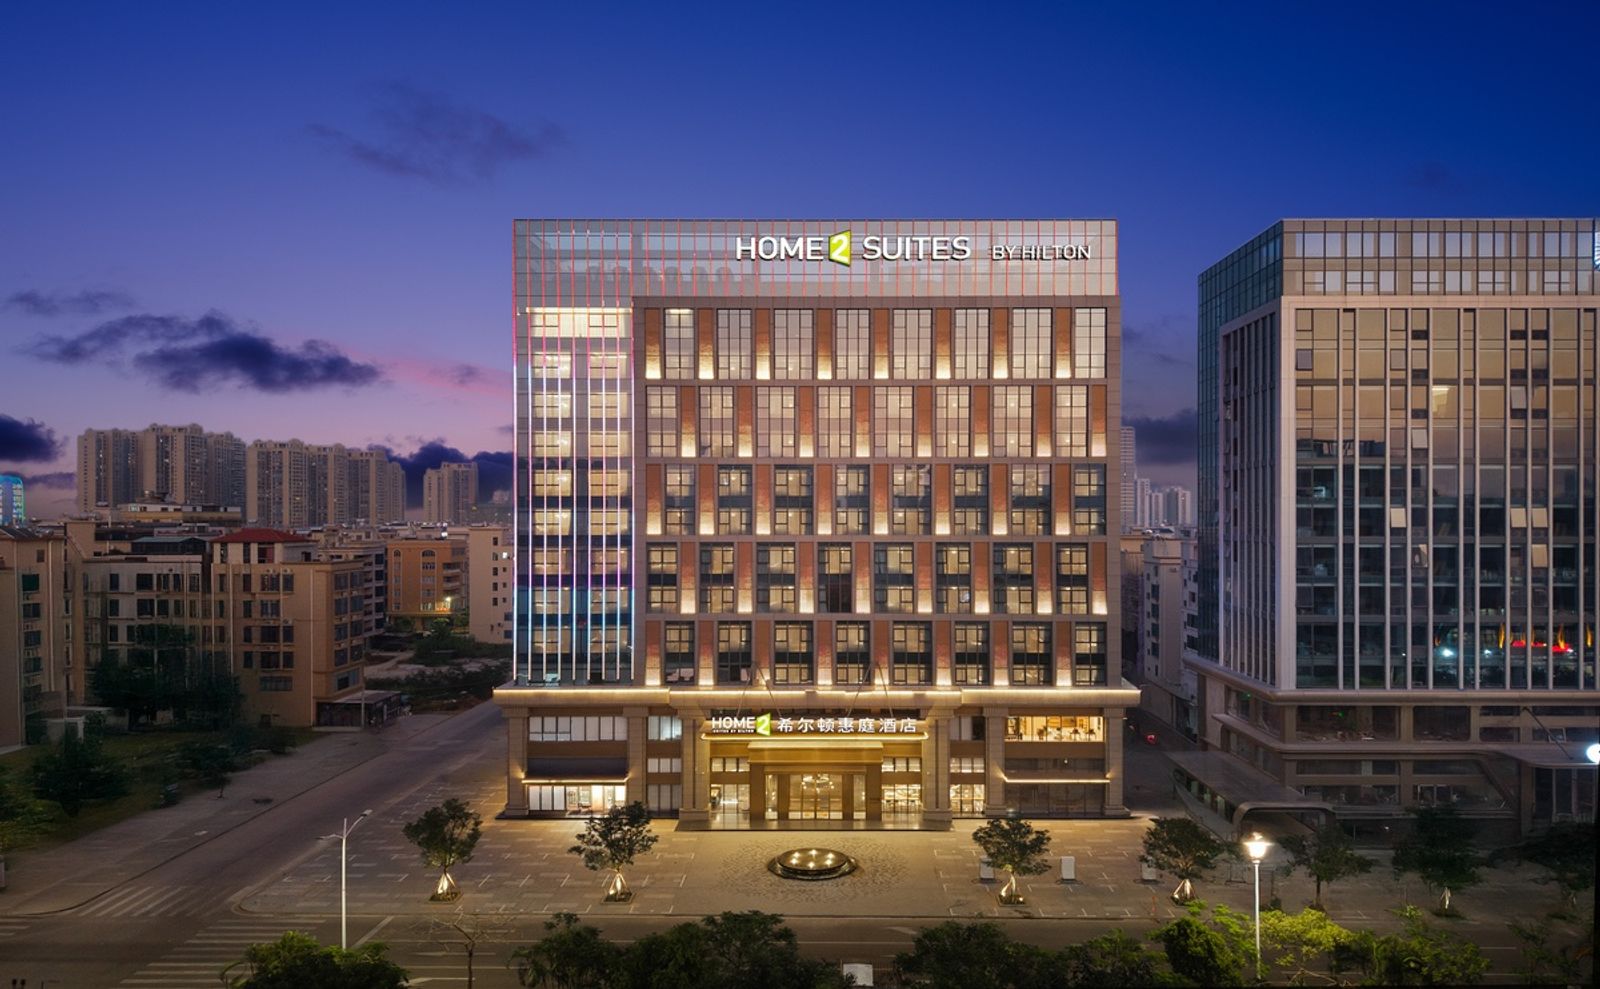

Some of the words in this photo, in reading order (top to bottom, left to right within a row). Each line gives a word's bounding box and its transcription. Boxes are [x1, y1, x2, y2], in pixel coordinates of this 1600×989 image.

[862, 236, 969, 260] SUITES
[991, 245, 1017, 260] BY
[1022, 245, 1091, 260] HILTON
[777, 717, 917, 733] 希尔顿惠庭酒店
